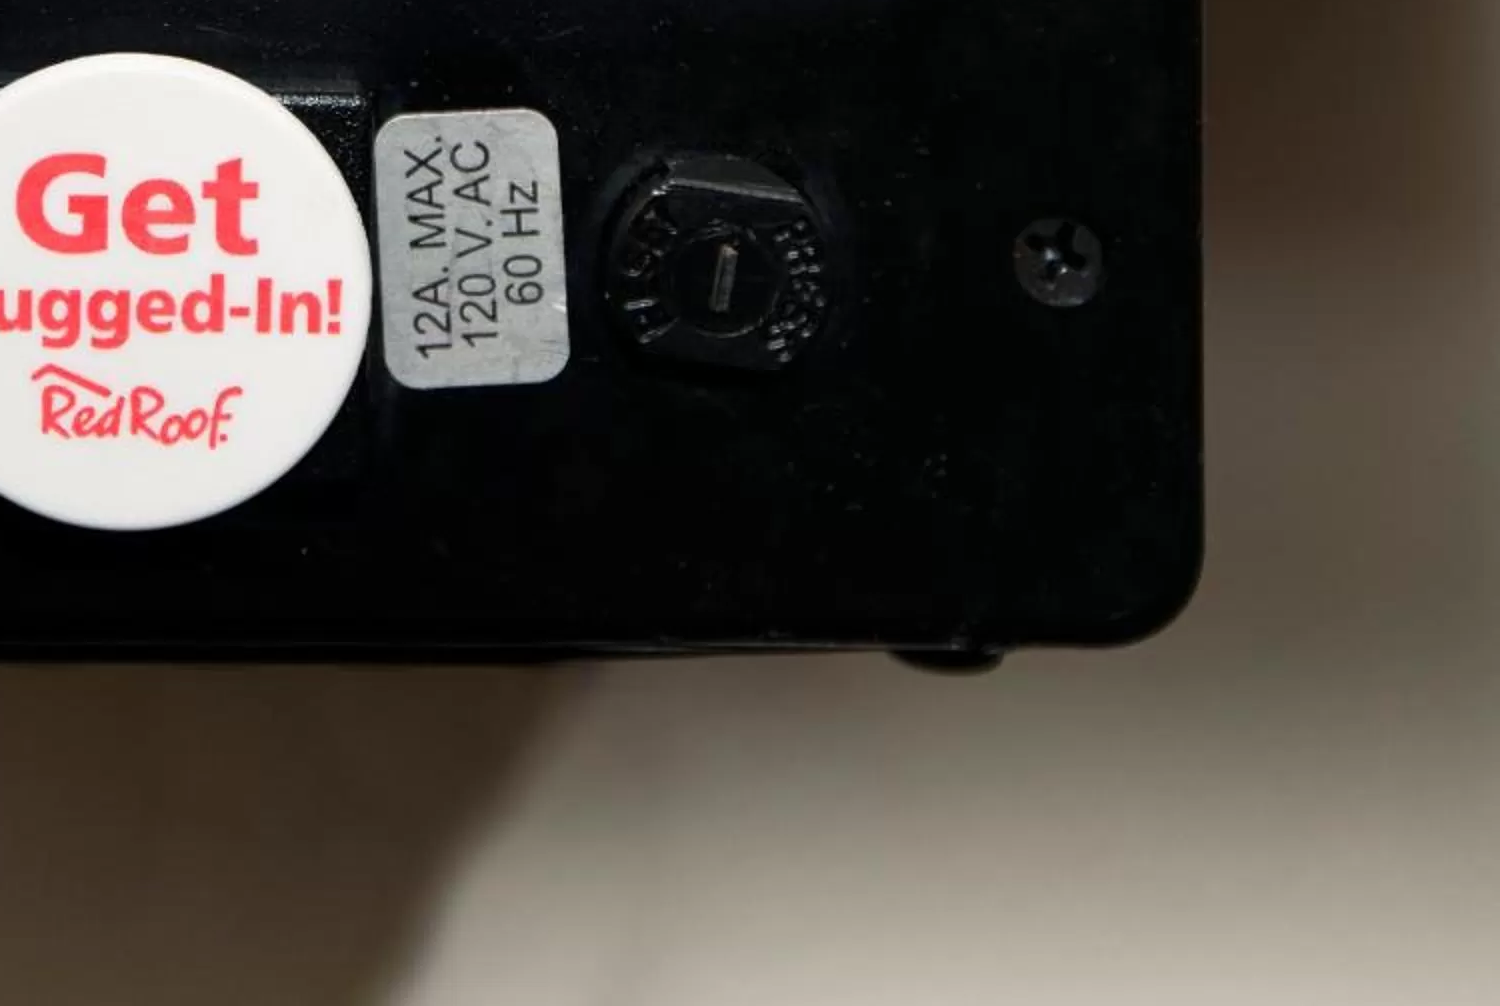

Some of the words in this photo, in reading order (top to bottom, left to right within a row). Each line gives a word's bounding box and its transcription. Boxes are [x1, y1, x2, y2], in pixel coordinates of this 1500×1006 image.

[15, 152, 260, 256] Get
[403, 135, 447, 250] MAX.
[499, 180, 541, 238] Hz
[411, 265, 453, 360] 12A.
[456, 273, 499, 348] 120
[504, 254, 545, 306] 60
